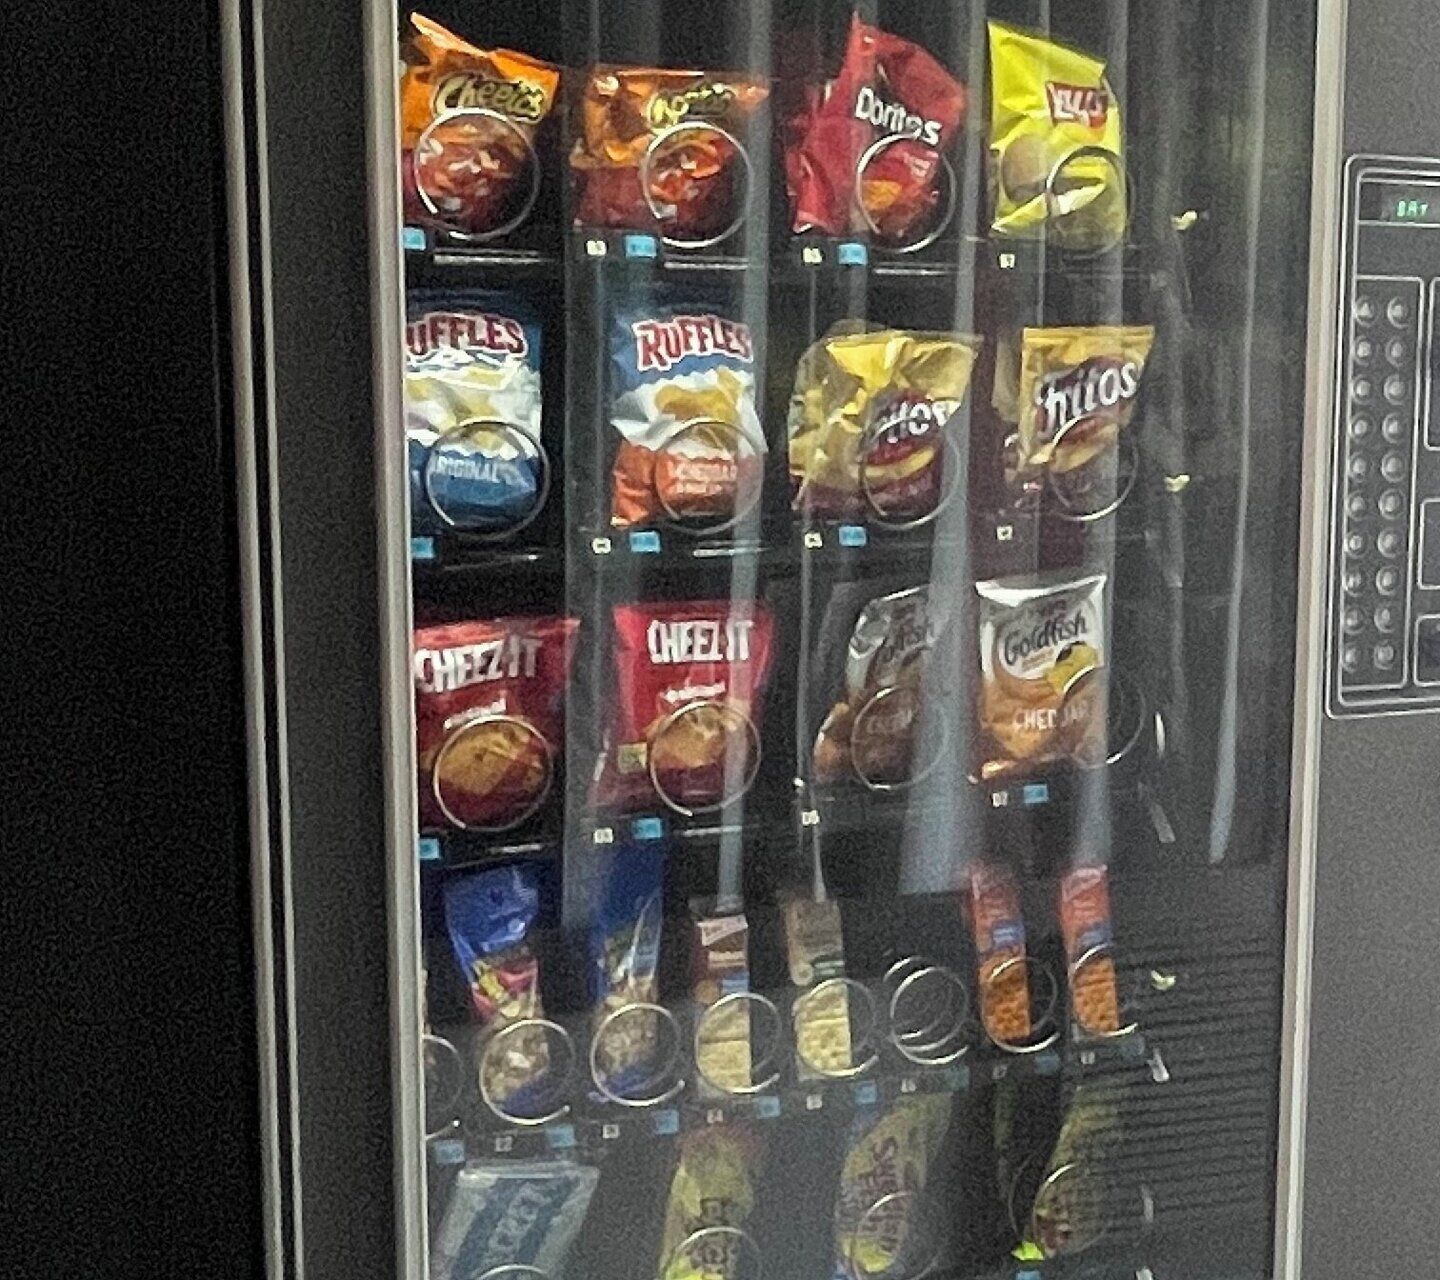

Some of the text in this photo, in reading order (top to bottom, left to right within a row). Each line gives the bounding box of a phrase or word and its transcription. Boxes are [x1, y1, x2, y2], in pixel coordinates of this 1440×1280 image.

[855, 86, 942, 145] Doritos
[406, 314, 525, 357] UFFLES
[635, 314, 754, 371] RUFFLES
[1002, 610, 1088, 667] Goldfish
